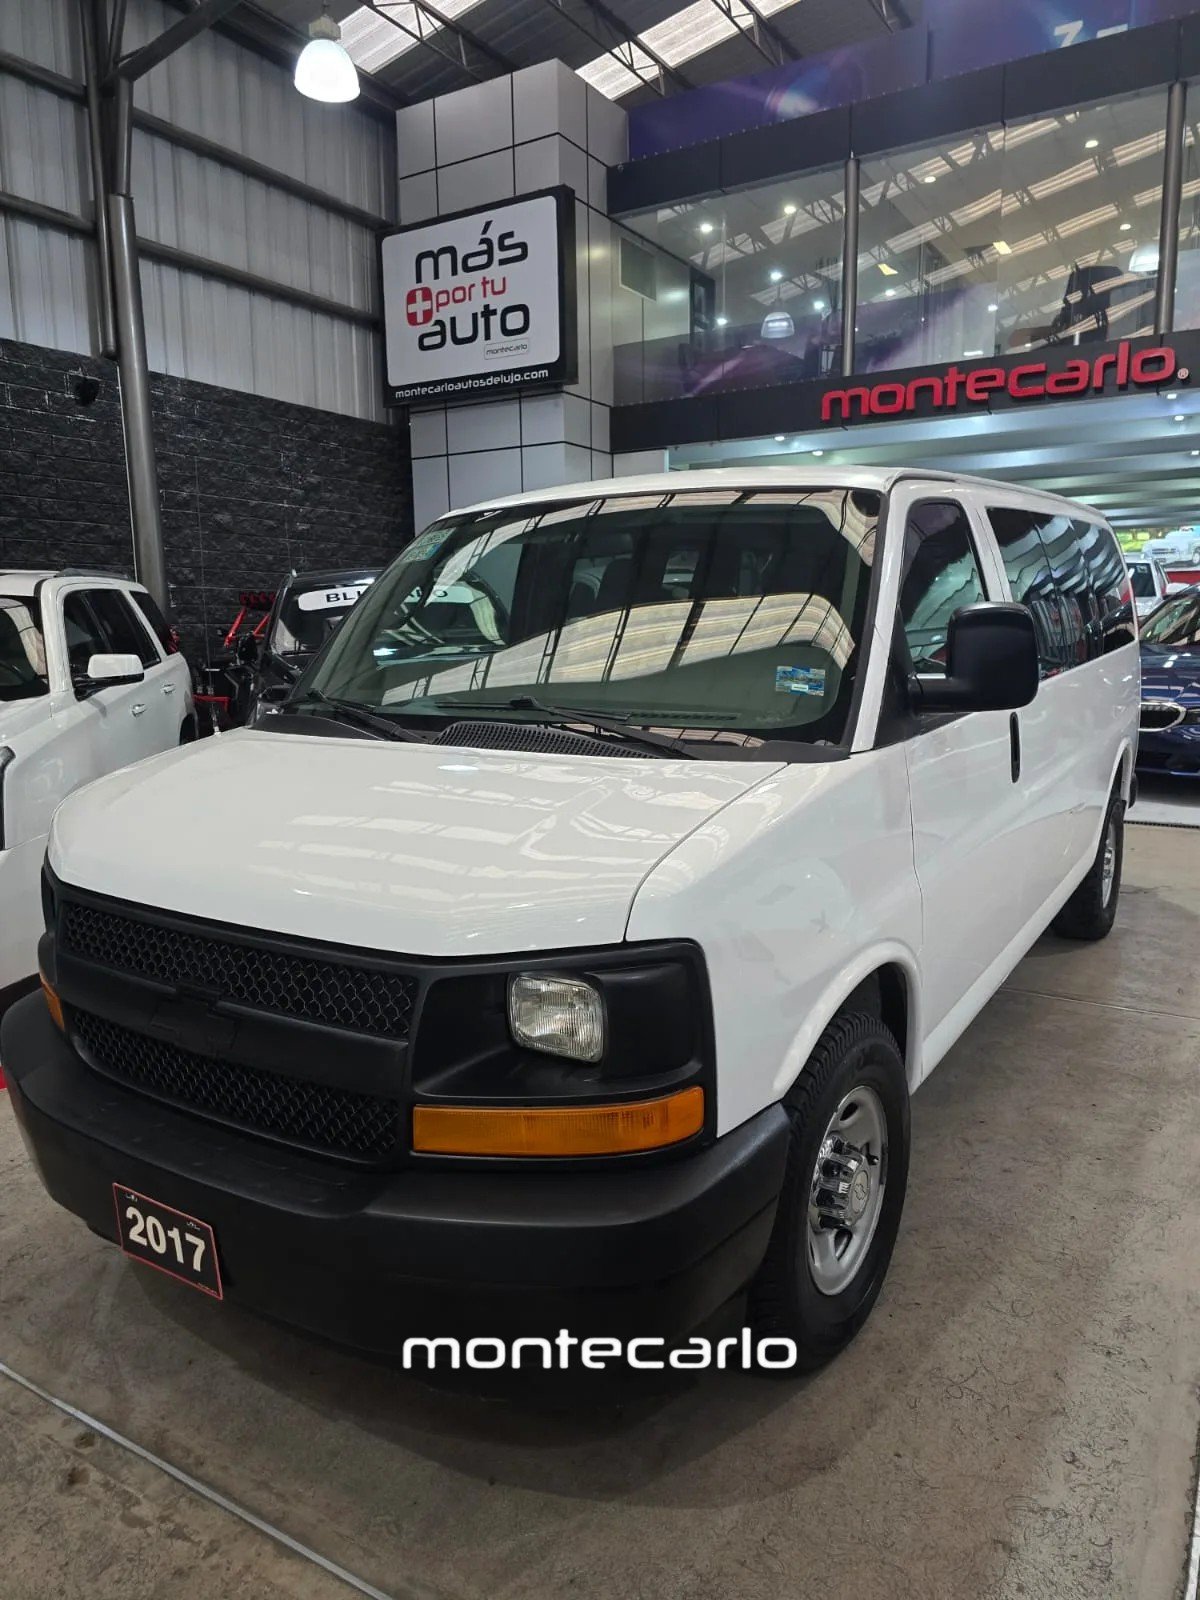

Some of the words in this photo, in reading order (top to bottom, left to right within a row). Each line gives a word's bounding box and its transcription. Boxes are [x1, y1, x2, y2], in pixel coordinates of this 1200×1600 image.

[415, 220, 529, 284] más
[435, 283, 476, 312] por
[480, 276, 507, 299] tu
[417, 303, 531, 351] auto
[485, 343, 528, 356] montecarlo
[395, 369, 549, 399] montecarloautosdelujo.com
[821, 341, 1176, 420] montecarlo
[126, 1206, 206, 1272] 2017
